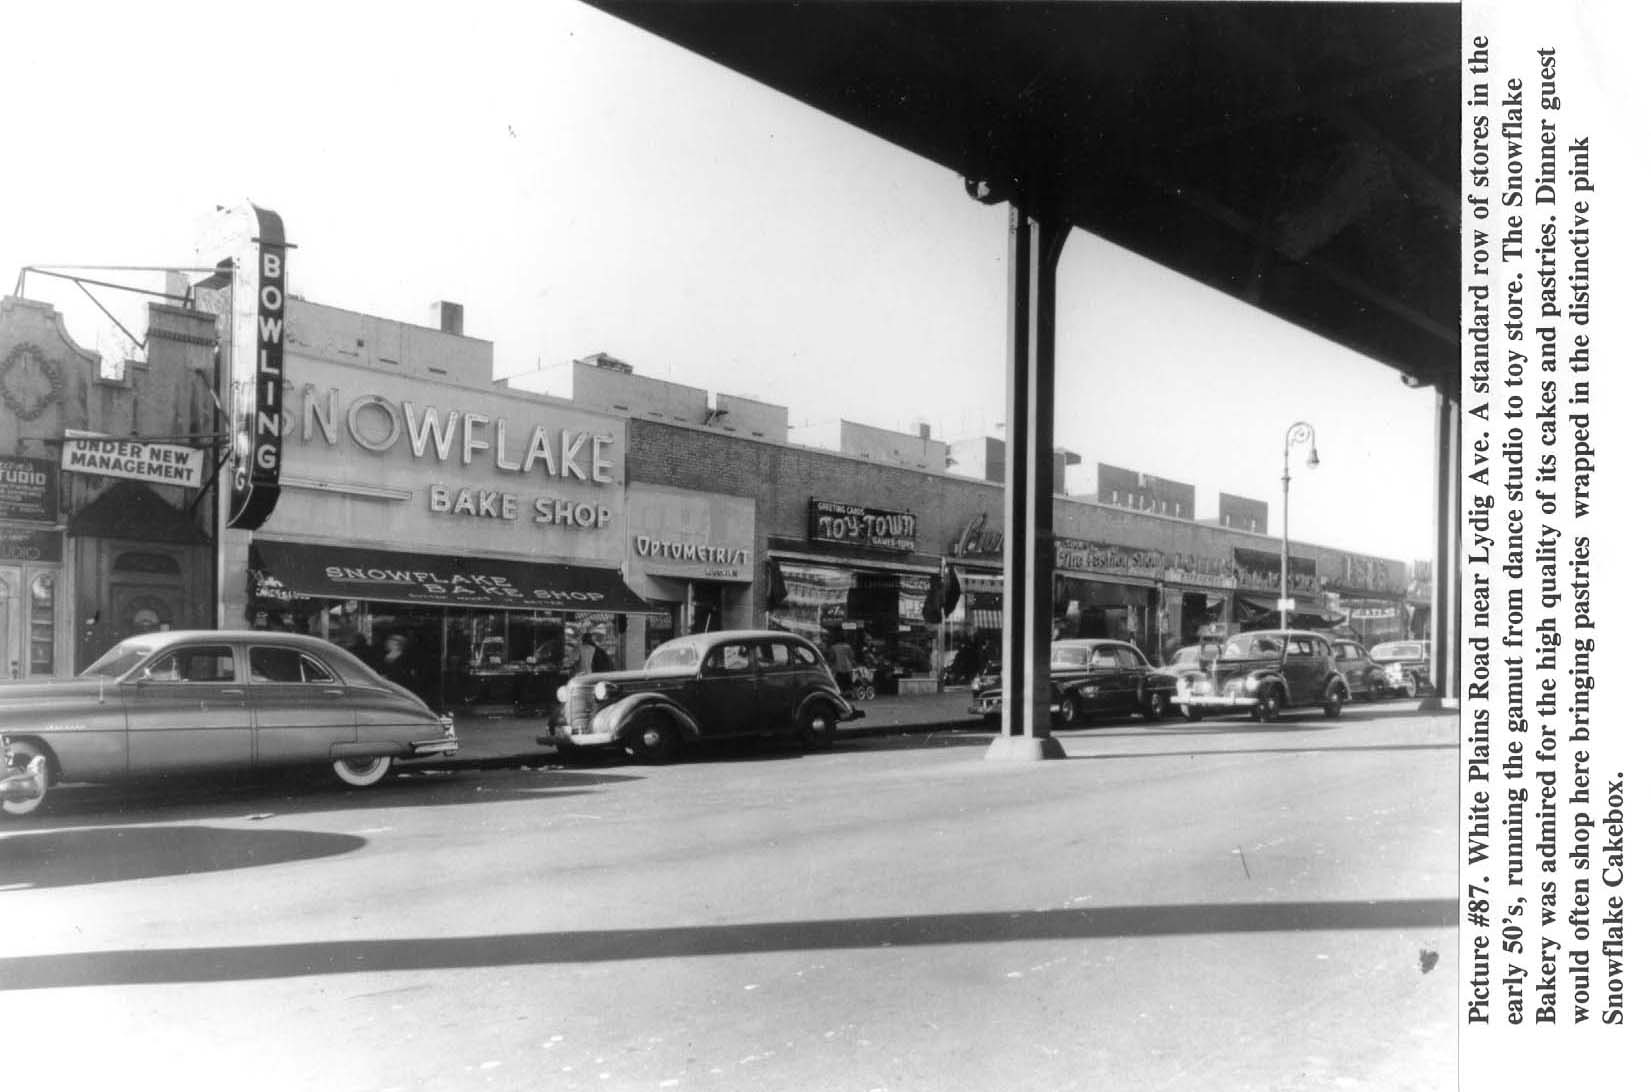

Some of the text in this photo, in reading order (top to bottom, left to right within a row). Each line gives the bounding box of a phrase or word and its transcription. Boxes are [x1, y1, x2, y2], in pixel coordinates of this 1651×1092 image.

[256, 253, 283, 469] BOWLING
[70, 451, 194, 481] MANAGEMENT
[75, 439, 190, 466] UNDER NEW
[430, 485, 611, 529] BAKE SHOP
[636, 535, 751, 565] OPTOMETRIST
[325, 566, 513, 588] SNOWFLAKE
[423, 583, 525, 598] BAKE
[533, 589, 605, 602] SHOP
